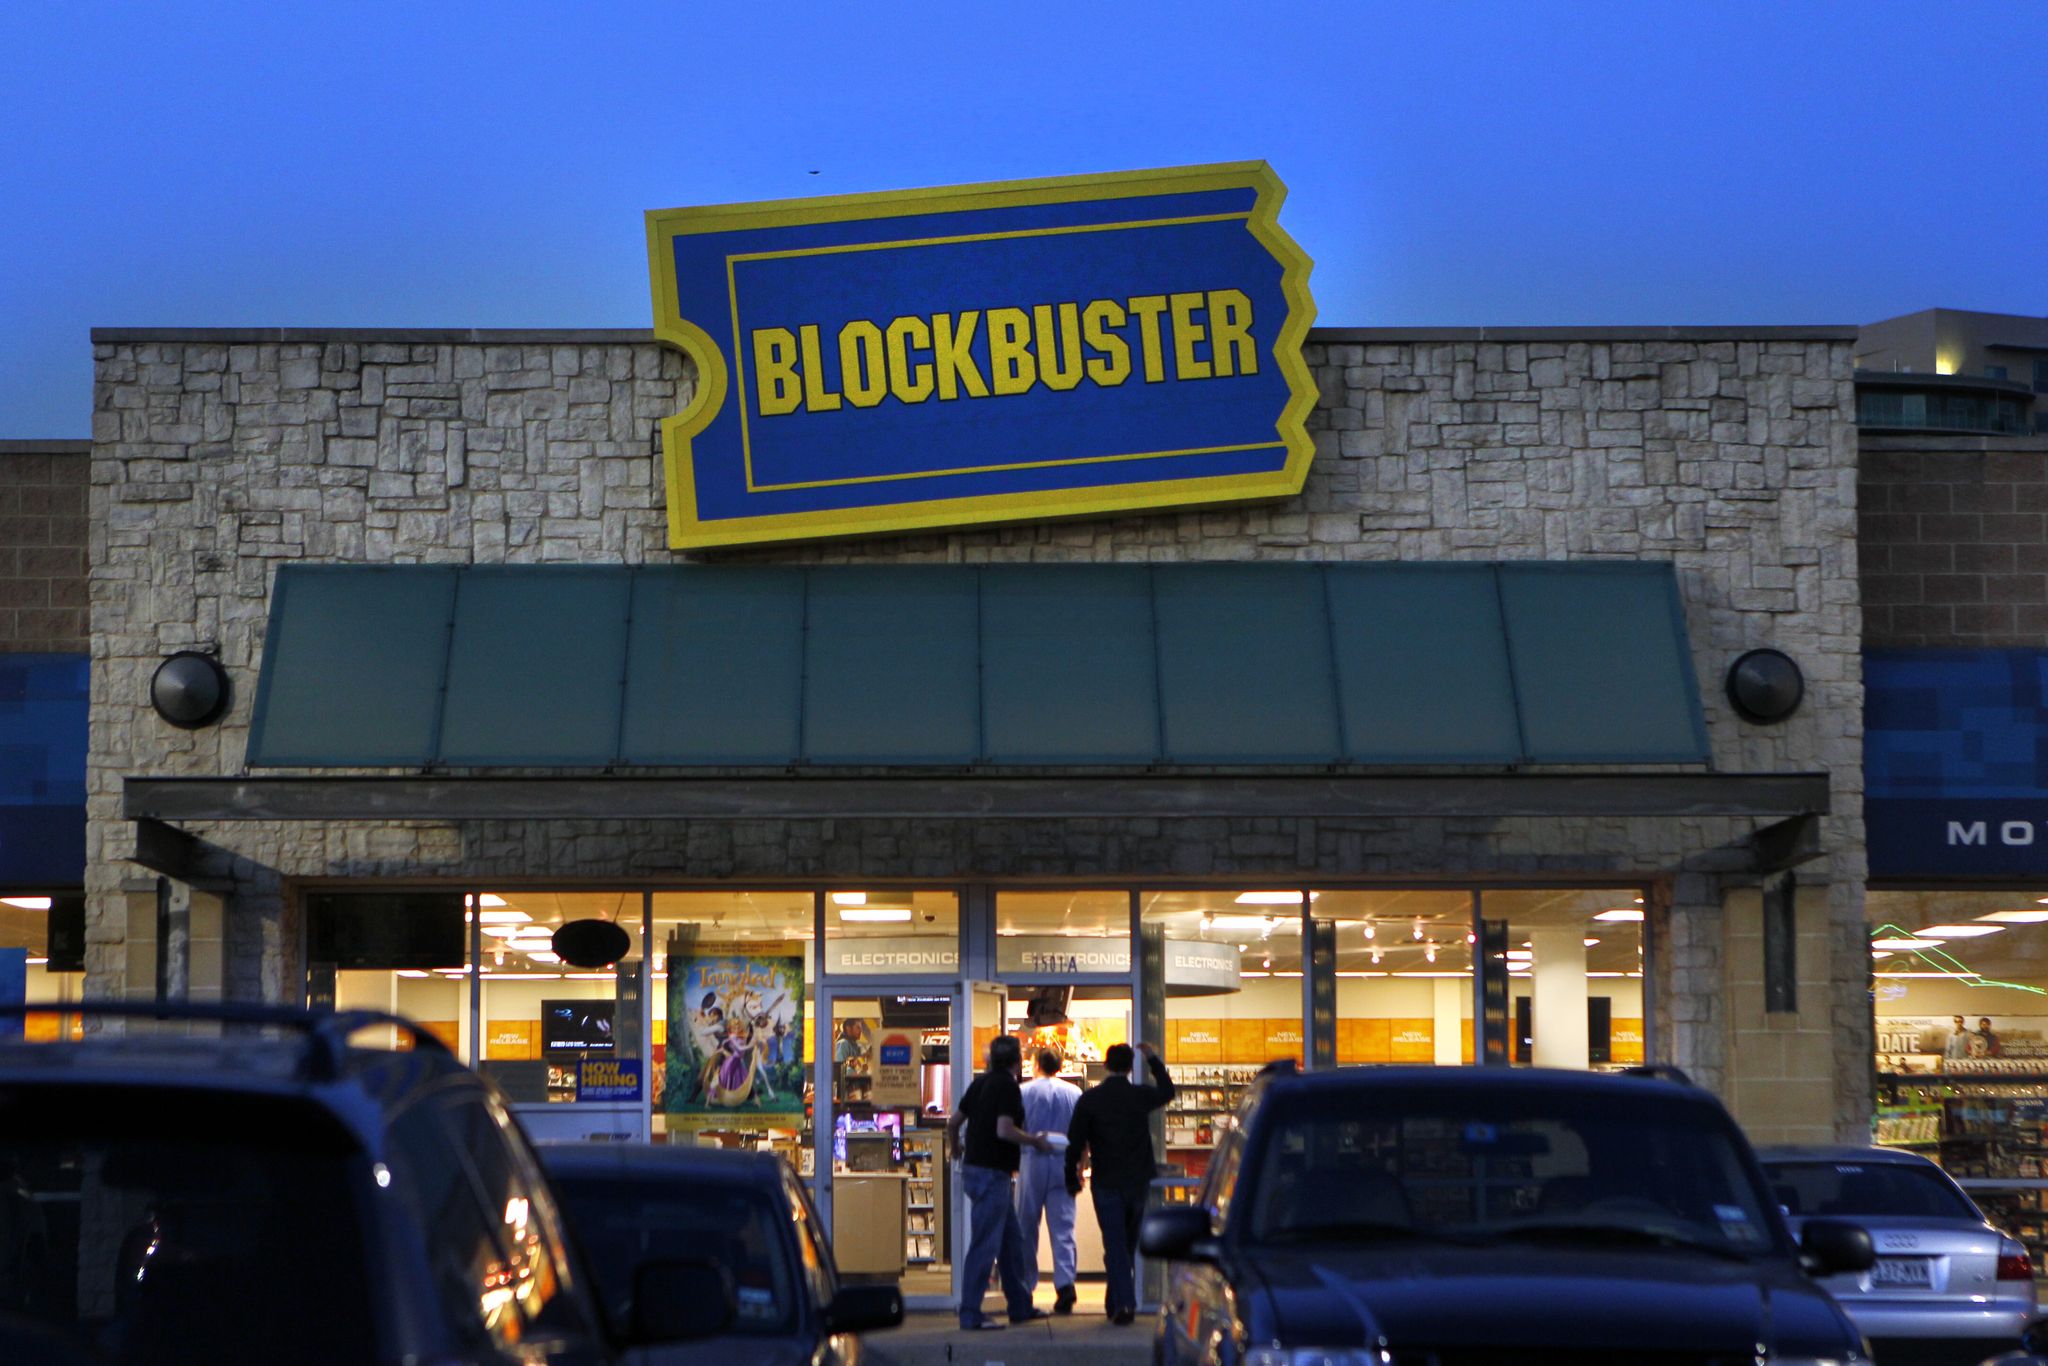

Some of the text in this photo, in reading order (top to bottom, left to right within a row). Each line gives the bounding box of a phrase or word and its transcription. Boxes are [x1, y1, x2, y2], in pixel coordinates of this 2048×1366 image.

[750, 288, 1259, 418] BLOCKBUSTER
[1947, 820, 2048, 846] MO
[1174, 955, 1234, 972] ELECTRONICS
[696, 962, 778, 995] Tangled
[1878, 1033, 1921, 1054] DATE
[580, 1061, 621, 1074] NOW
[580, 1073, 638, 1087] HIRING
